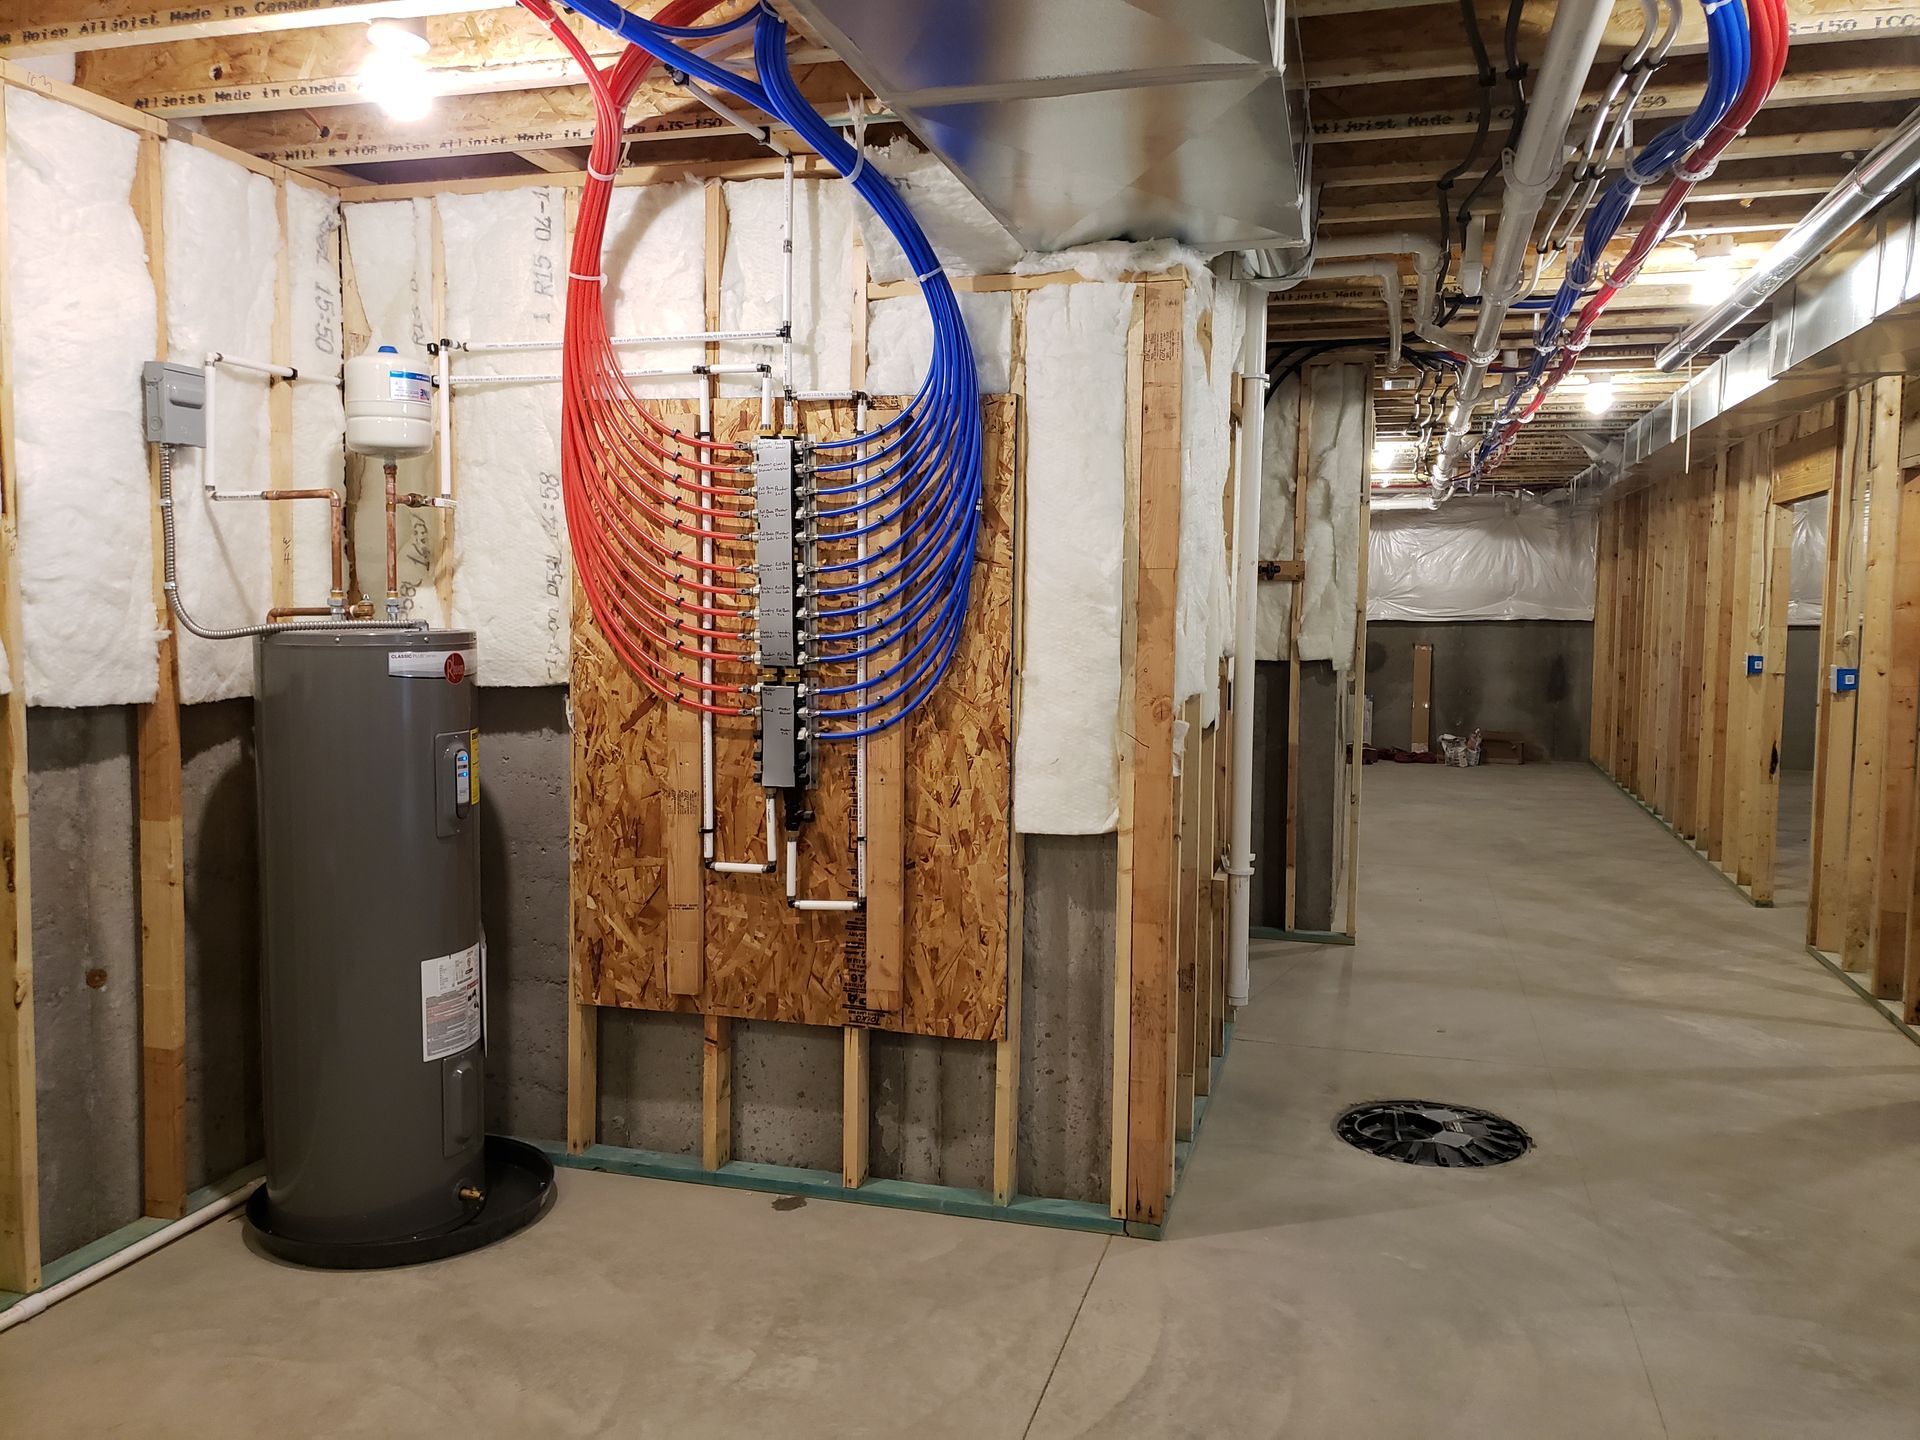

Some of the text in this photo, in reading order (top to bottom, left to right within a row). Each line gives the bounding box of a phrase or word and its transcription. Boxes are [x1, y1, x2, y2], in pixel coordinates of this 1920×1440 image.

[169, 9, 212, 23] Made
[224, 6, 246, 17] in
[214, 90, 252, 103] Made
[262, 87, 281, 98] in
[289, 82, 346, 97] Canada
[1407, 112, 1455, 127] Made
[533, 254, 554, 297] R15
[314, 281, 335, 355] 15:50
